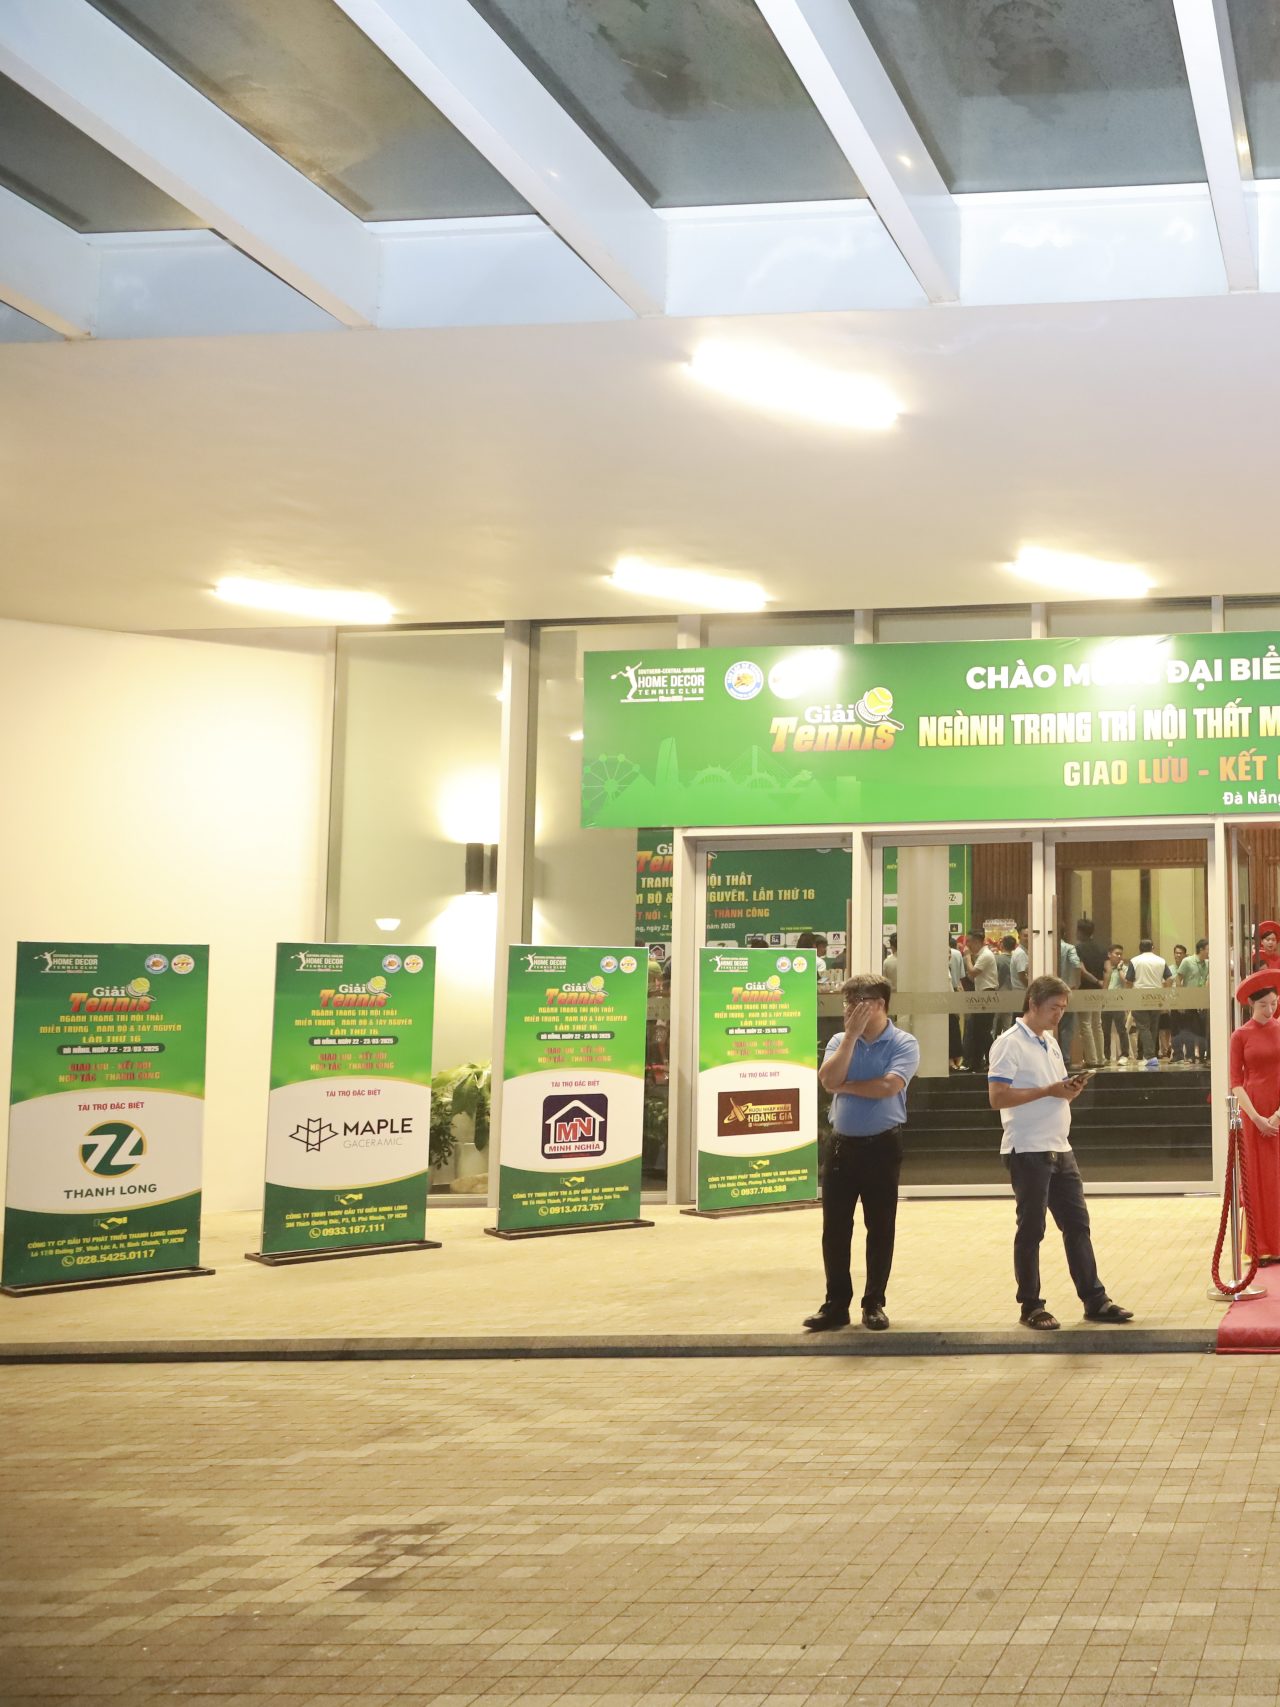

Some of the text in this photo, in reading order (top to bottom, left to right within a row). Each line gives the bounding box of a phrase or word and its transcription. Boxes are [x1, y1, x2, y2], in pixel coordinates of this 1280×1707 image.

[638, 674, 705, 688] HOME DECOR
[966, 659, 1057, 690] CHÀO
[1167, 659, 1222, 691] ĐẠI
[804, 704, 856, 723] Giải
[918, 710, 1004, 747] NGÀNH
[1010, 711, 1092, 745] TRANG
[1098, 705, 1136, 742] TRÍ
[1143, 703, 1187, 747] NỘI
[1193, 698, 1253, 739] THẤT
[769, 716, 896, 752] Tennis
[1063, 760, 1128, 787] GIAO
[1138, 756, 1189, 784] LƯU
[1219, 748, 1267, 782] KẾT
[1223, 791, 1243, 805] Đà
[656, 843, 673, 856] Gi
[641, 876, 673, 889] TRAN
[725, 871, 753, 887] THẤT
[647, 891, 663, 906] BỘ
[753, 886, 774, 901] LẦN
[777, 888, 800, 901] THỨ
[802, 889, 816, 900] 16
[714, 908, 743, 919] THÀNH
[746, 907, 770, 918] CÔNG
[53, 958, 98, 966] HOME DECOR
[324, 957, 344, 965] DECOR
[92, 986, 126, 997] Giải
[338, 984, 367, 994] Giải
[562, 983, 587, 993] Giải
[745, 982, 767, 991] Giải
[69, 993, 151, 1012] Tennis
[320, 989, 387, 1007] Tennis
[546, 988, 605, 1005] Tennis
[747, 1111, 793, 1123] HOÀNG GIA
[343, 1117, 413, 1136] MAPLE
[556, 1117, 593, 1142] MN
[343, 1137, 403, 1149] GACERAMIC
[64, 1183, 158, 1200] THANH LONG
[549, 1203, 604, 1215] 0913.473.757
[322, 1223, 385, 1237] 0933.187.111
[77, 1249, 156, 1265] 028.5425.0117
